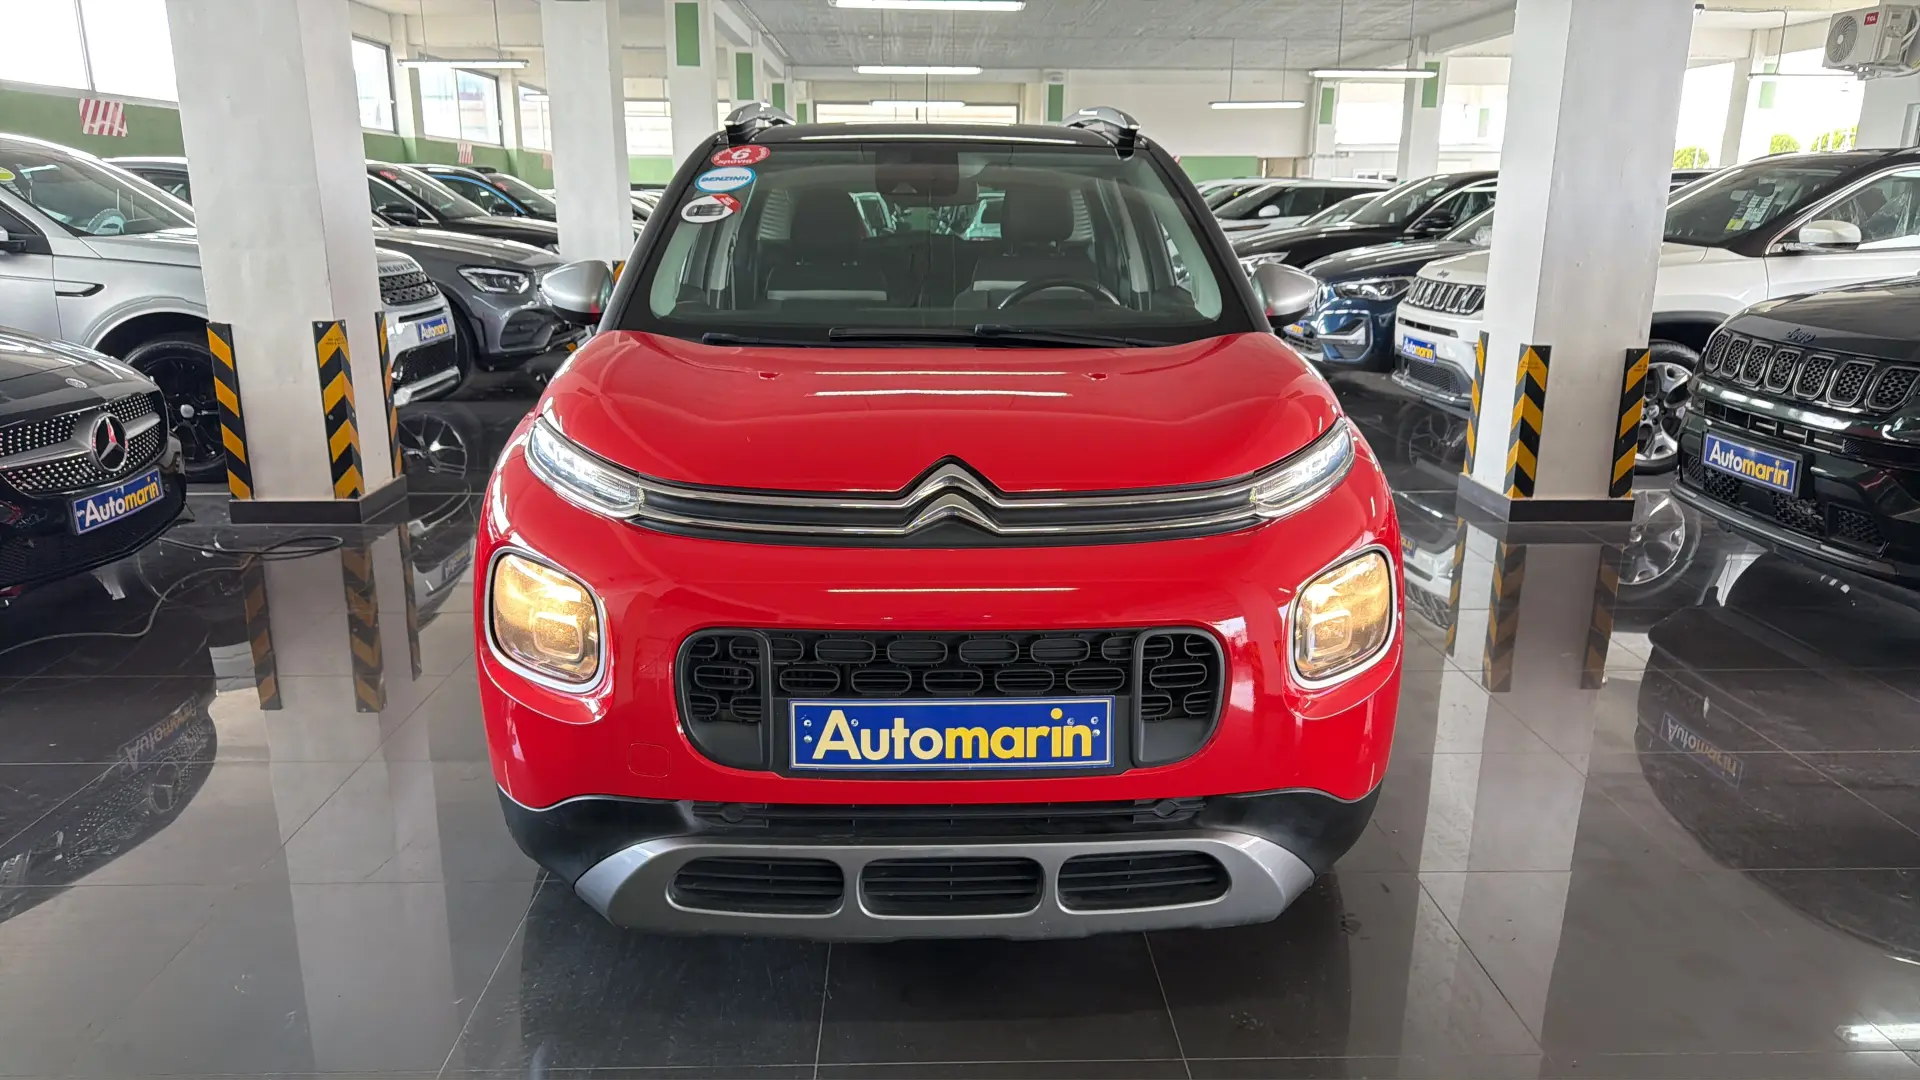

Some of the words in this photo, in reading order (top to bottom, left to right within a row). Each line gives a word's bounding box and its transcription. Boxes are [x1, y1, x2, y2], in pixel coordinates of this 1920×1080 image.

[731, 147, 752, 160] 6
[1708, 440, 1790, 487] Automarin
[84, 475, 160, 528] Automarin
[811, 707, 1093, 760] Automarin
